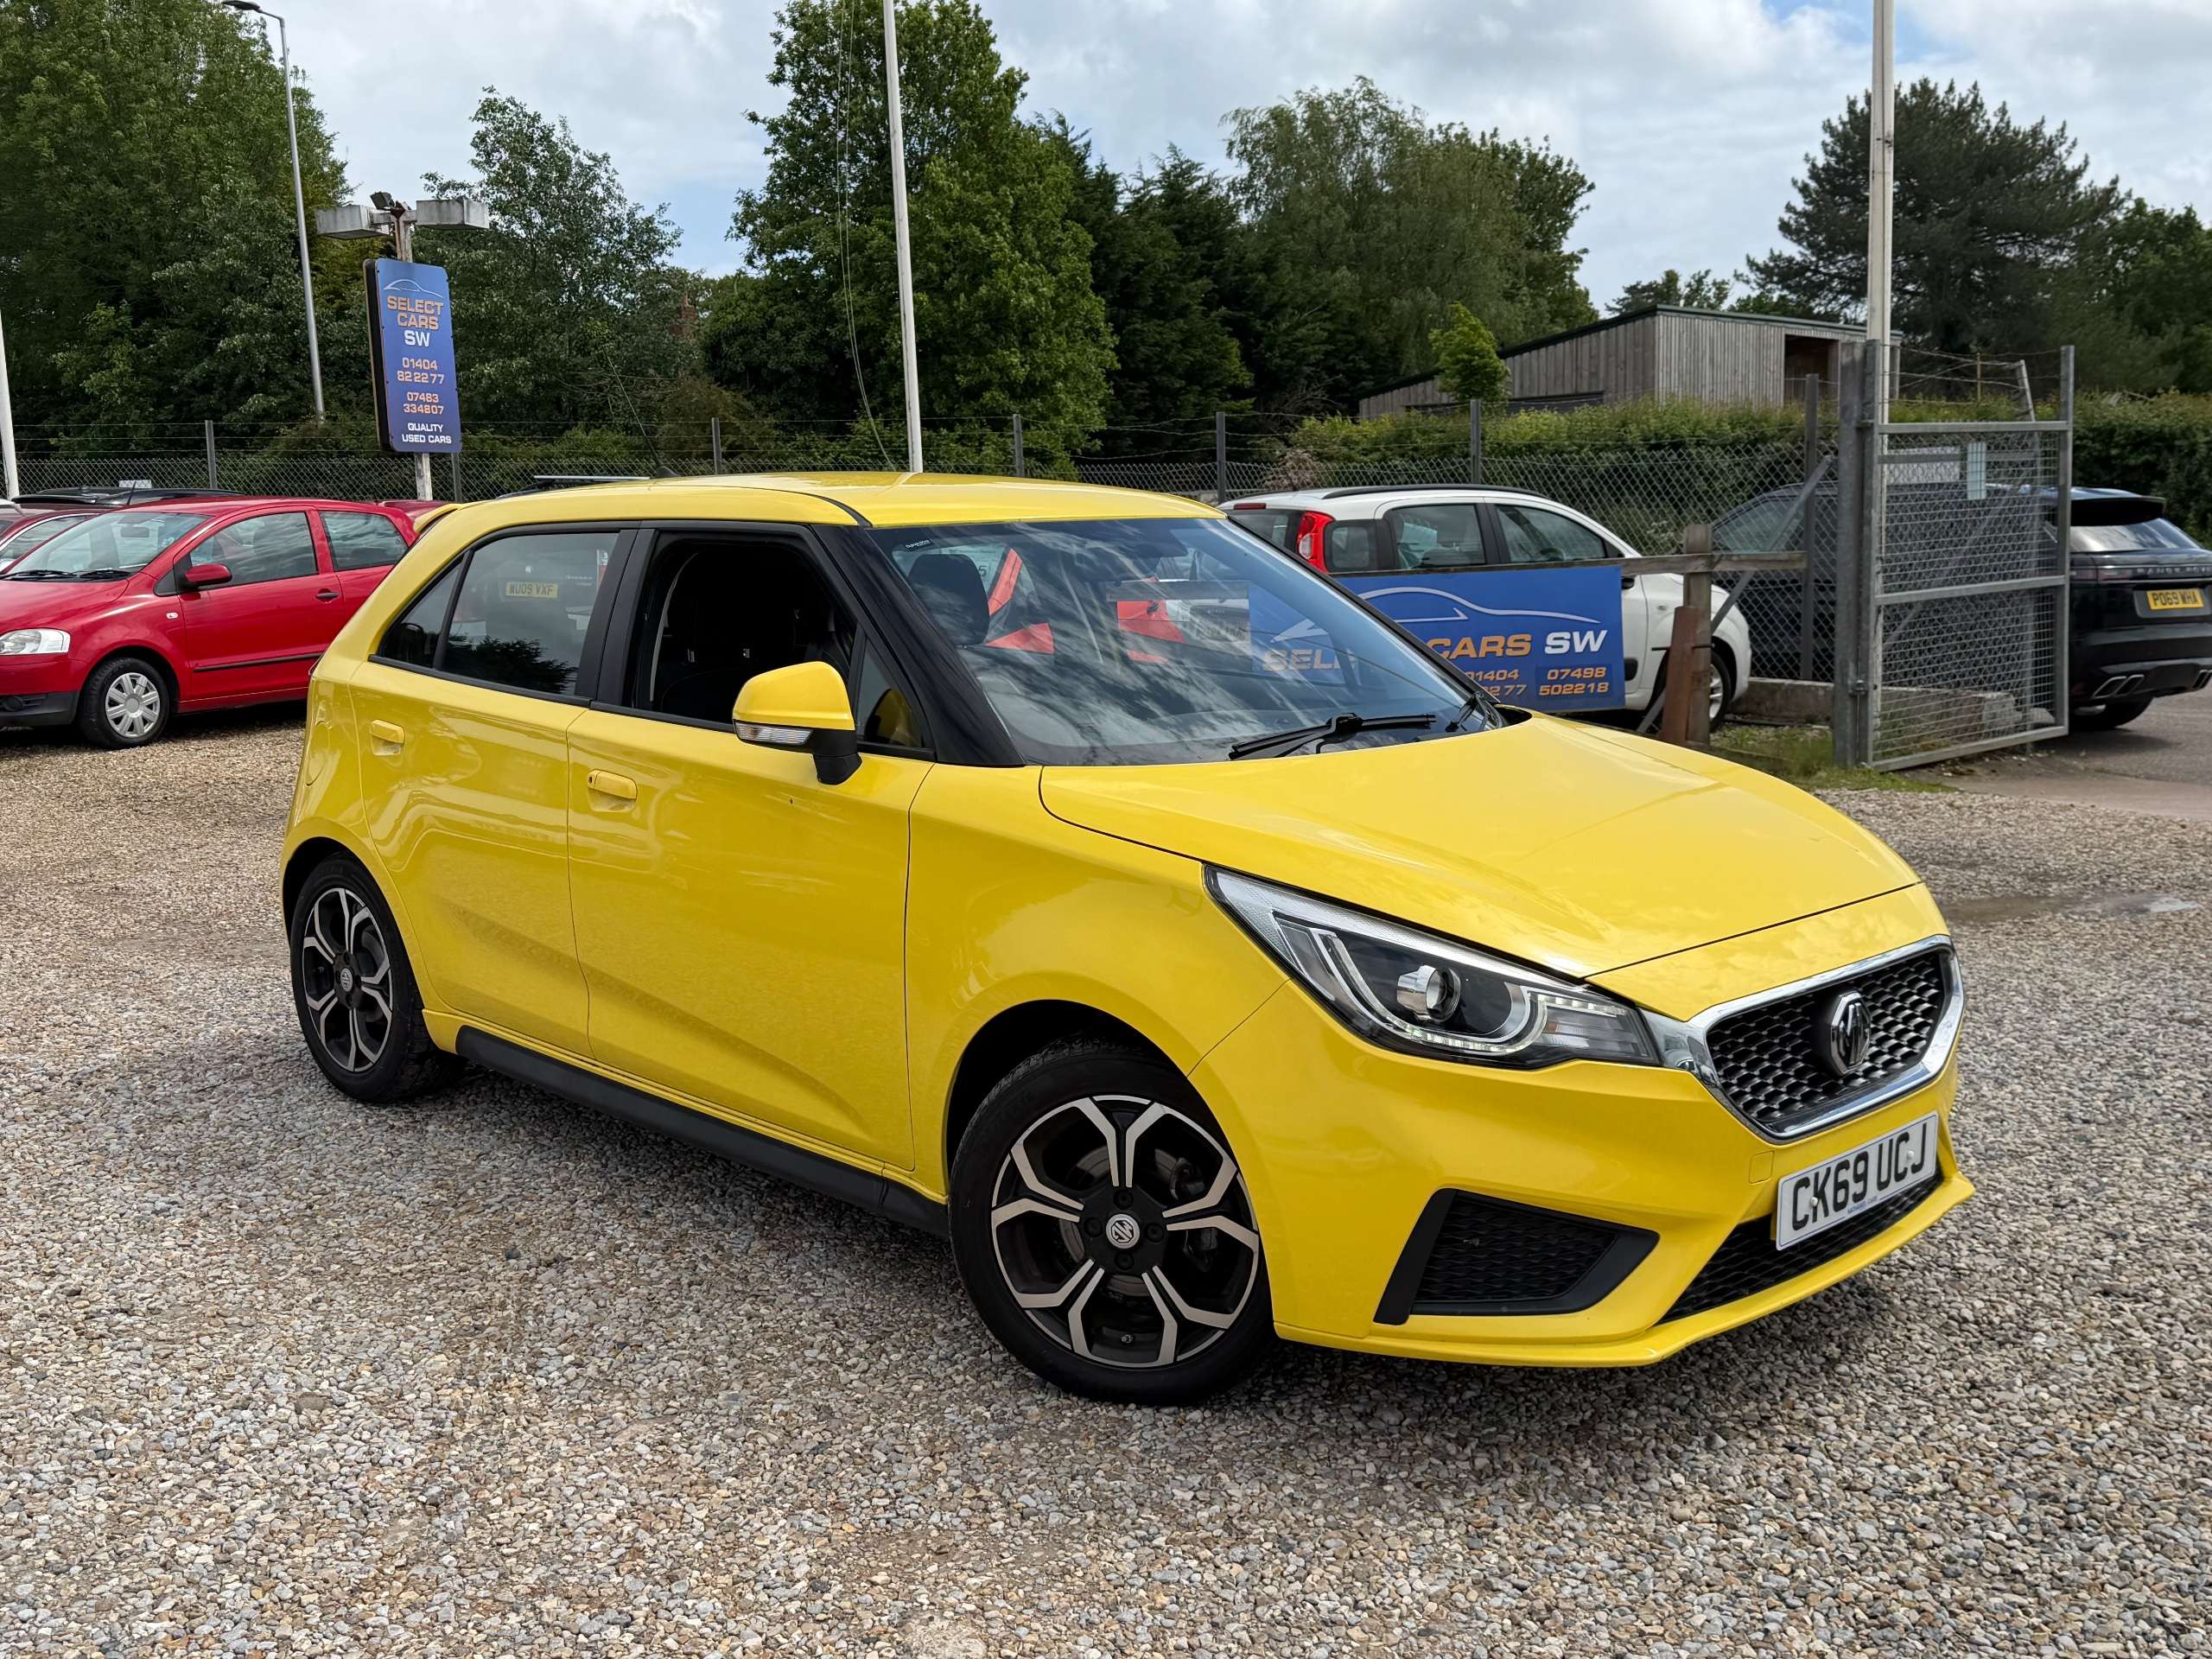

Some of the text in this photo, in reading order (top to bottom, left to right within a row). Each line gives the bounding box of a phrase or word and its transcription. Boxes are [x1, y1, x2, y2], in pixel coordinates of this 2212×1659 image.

[387, 296, 443, 315] SELECT
[397, 313, 439, 330] CARS
[404, 329, 430, 346] SW
[402, 357, 438, 371] 01404
[404, 404, 444, 415] 334807
[408, 423, 443, 433] QUALITY
[402, 434, 452, 444] USED CARS
[536, 583, 554, 595] VXF
[2152, 591, 2178, 606] PO69
[1262, 629, 1607, 671] SEL CARS SW
[1547, 666, 1607, 681] 07498
[1538, 681, 1609, 696] 502218
[1791, 1122, 1927, 1231] CK69 UCJ
[1111, 1219, 1134, 1243] MG
